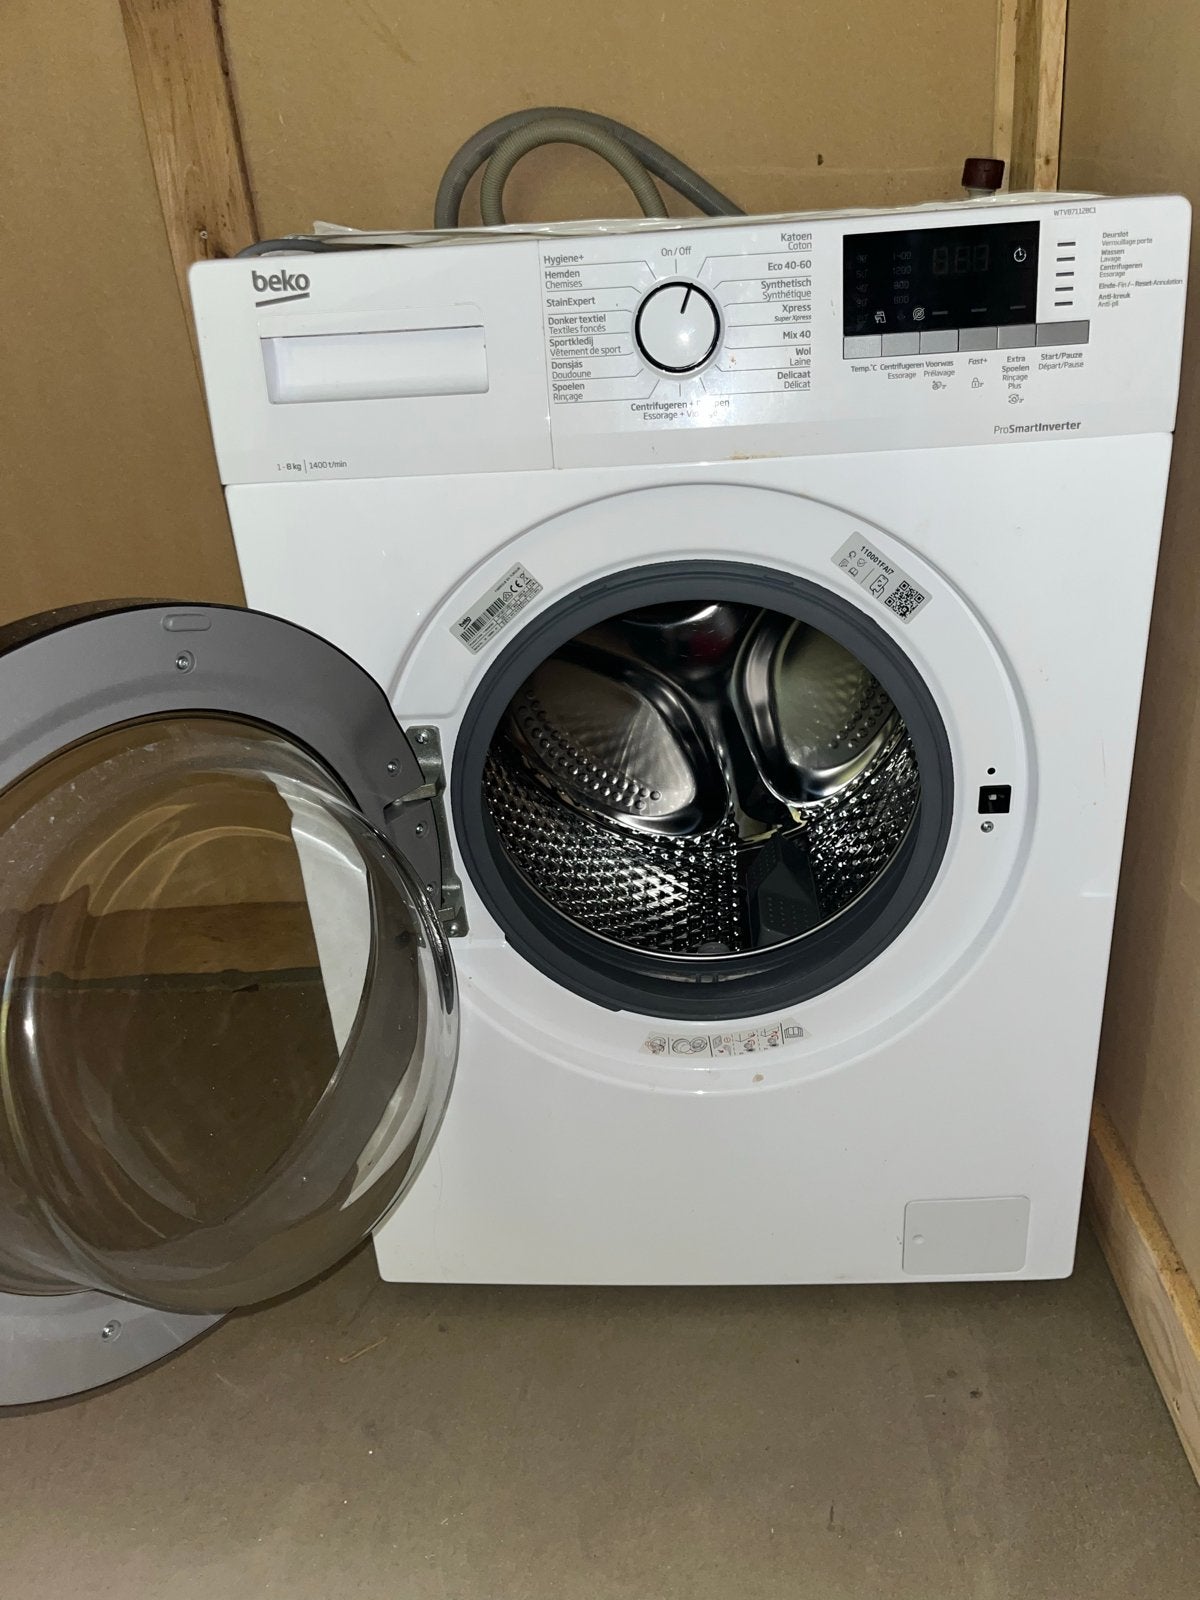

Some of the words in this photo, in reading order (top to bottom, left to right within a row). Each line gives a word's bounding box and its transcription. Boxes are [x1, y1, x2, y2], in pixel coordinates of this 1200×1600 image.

[780, 232, 812, 242] Katoen
[661, 247, 673, 256] On
[679, 246, 692, 255] Off
[788, 242, 812, 251] Coton
[543, 254, 584, 265] Hygiene+
[767, 262, 783, 271] Eco
[785, 260, 811, 270] 40-60
[1100, 263, 1143, 271] Centrifugeren
[544, 270, 580, 279] Hemden
[251, 270, 311, 293] beko
[545, 279, 583, 290] Chemises
[761, 279, 811, 291] Synthetisch
[762, 289, 811, 302] Synthétique
[546, 297, 596, 308] StainExpert
[782, 304, 811, 314] Xpress
[548, 316, 579, 326] Donker
[579, 314, 607, 323] textiel
[774, 315, 791, 323] Super
[792, 314, 812, 322] Xpress
[549, 325, 579, 335] Textiles
[580, 323, 607, 333] foncés
[783, 331, 798, 340] Mix
[798, 330, 811, 339] 40
[549, 337, 594, 349] Sportkledij
[550, 347, 589, 357] Vêtement
[589, 346, 600, 355] de
[600, 346, 621, 357] sport
[795, 347, 811, 356] Wol
[1040, 352, 1083, 360] Start/Pauze
[789, 358, 811, 367] Laine
[925, 360, 954, 368] Voorwas
[968, 357, 988, 365] Fast+
[1006, 355, 1026, 363] Extra
[551, 359, 583, 371] Donsjas
[880, 362, 924, 371] Centrifugeren
[1001, 365, 1030, 373] Spoelen
[1038, 361, 1084, 371] Départ/Pause
[552, 370, 592, 380] Doudoune
[777, 370, 811, 380] Delicaat
[923, 369, 955, 378] Prélavage
[1002, 374, 1029, 382] Rinçage
[552, 382, 585, 392] Spoelen
[784, 380, 810, 390] Délicat
[553, 392, 583, 402] Rinçage
[630, 401, 688, 412] Centrifugeren
[643, 412, 678, 421] Essorage
[993, 421, 1082, 435] ProSmartInverter
[309, 461, 327, 469] 1400
[328, 460, 347, 468] t/min
